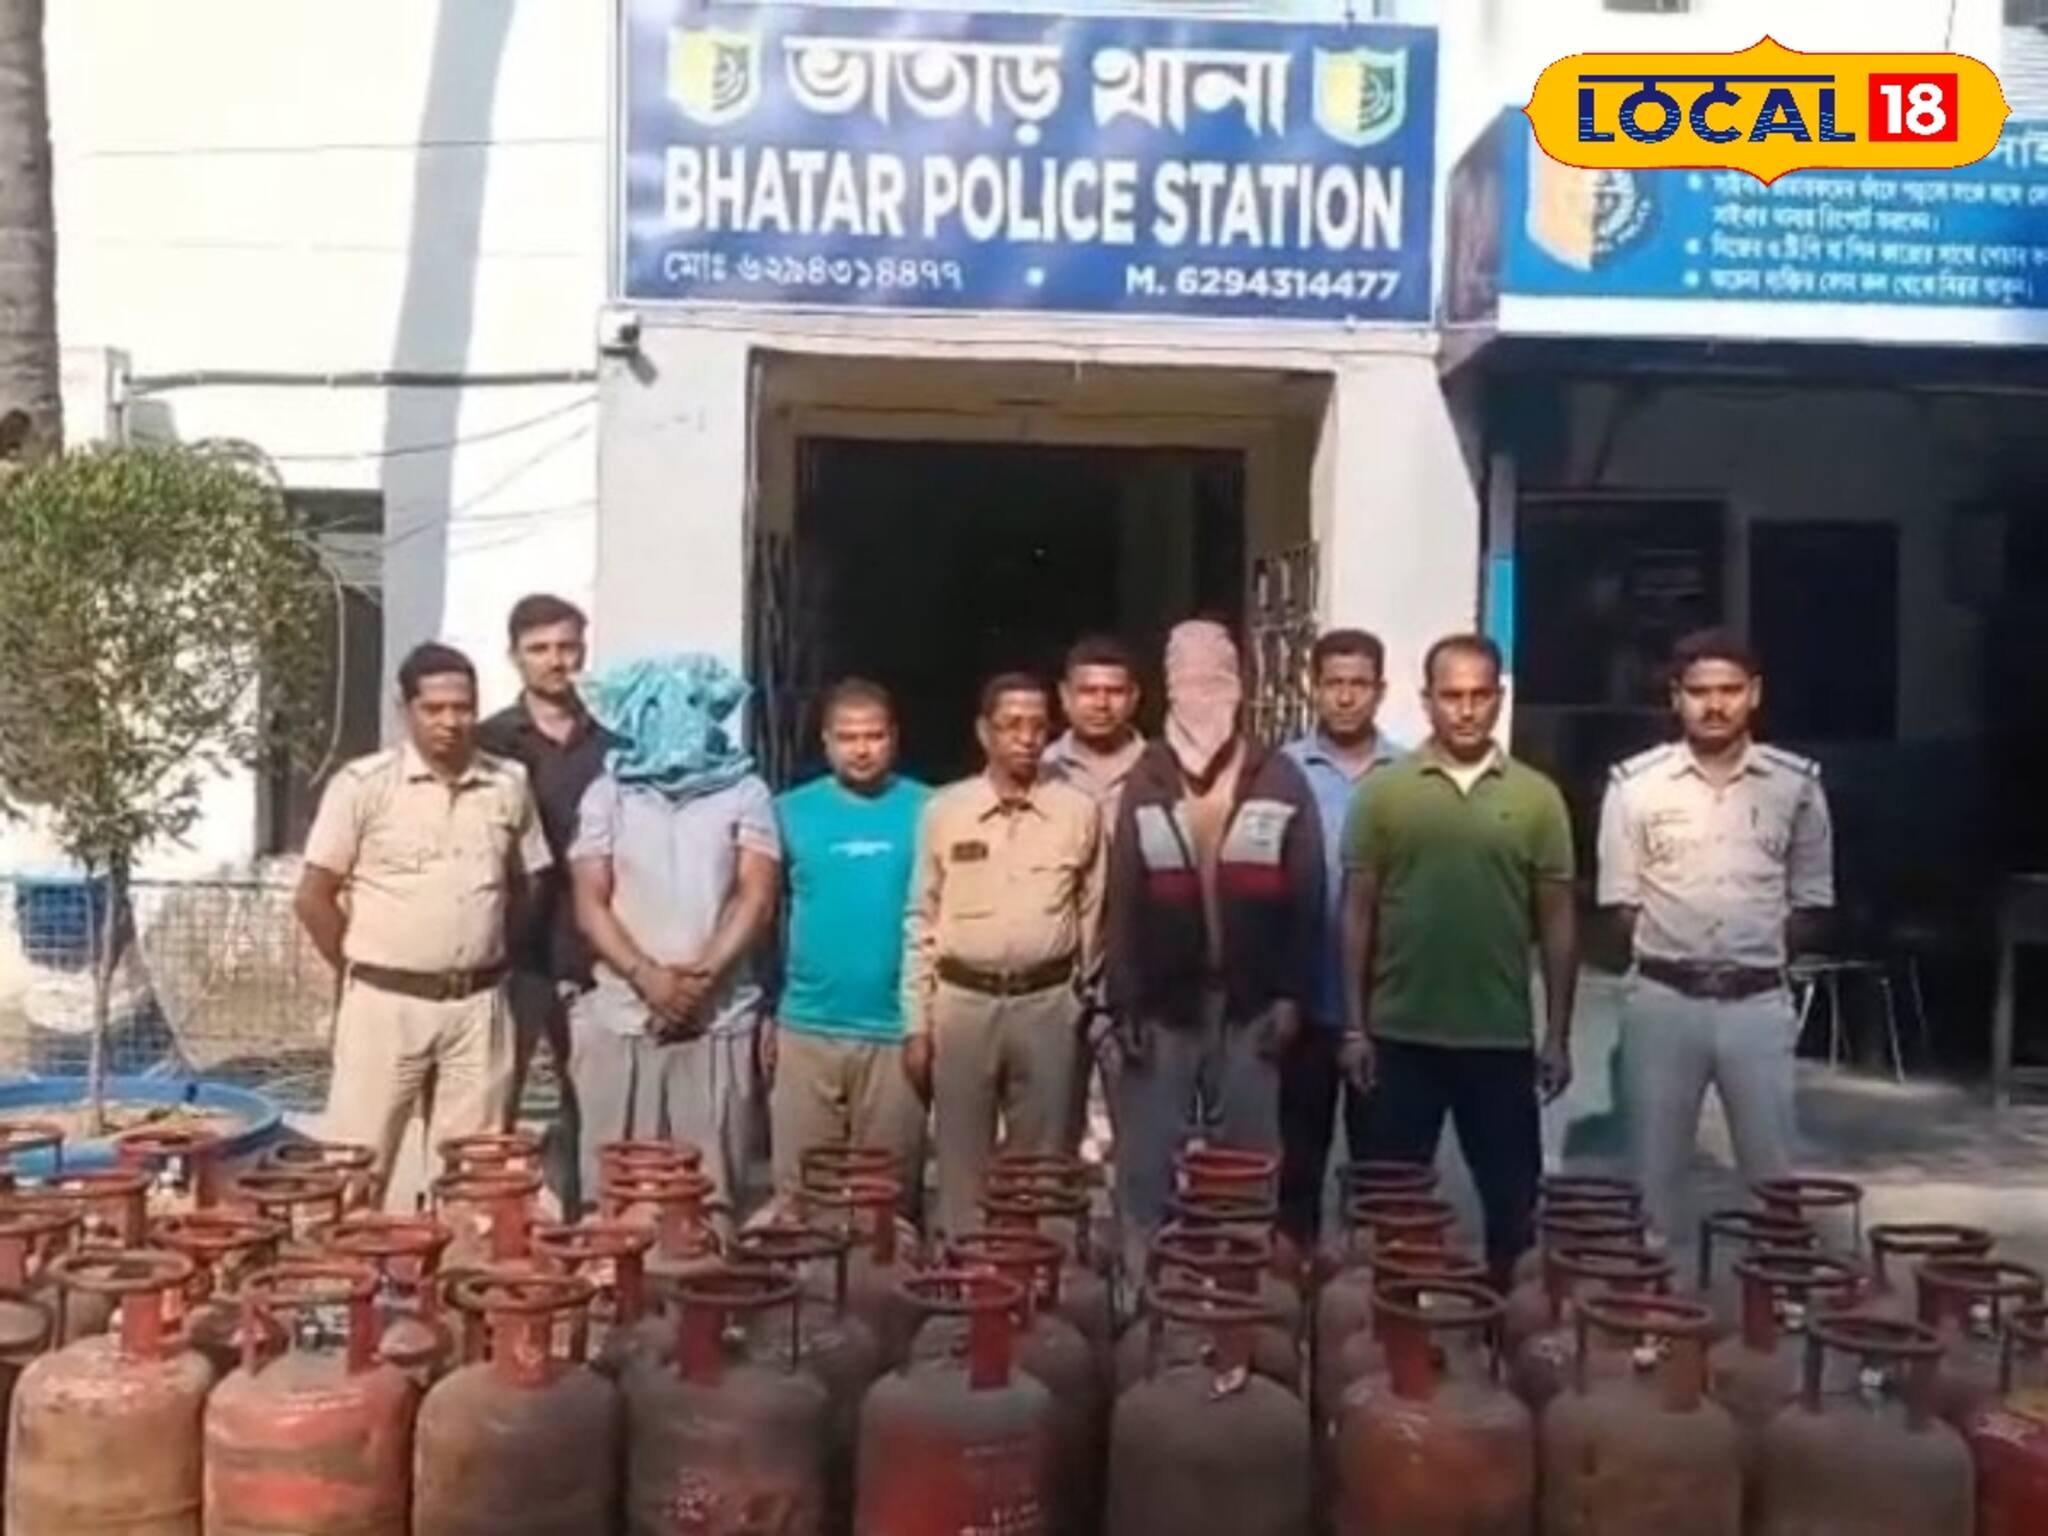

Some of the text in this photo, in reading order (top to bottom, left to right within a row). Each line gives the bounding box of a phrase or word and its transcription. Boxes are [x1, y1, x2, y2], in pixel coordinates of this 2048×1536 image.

[781, 34, 1293, 146] ভাতাড় থানা
[664, 145, 1403, 251] BHATAR POLICE STATION
[1125, 264, 1402, 301] M. 6294314477
